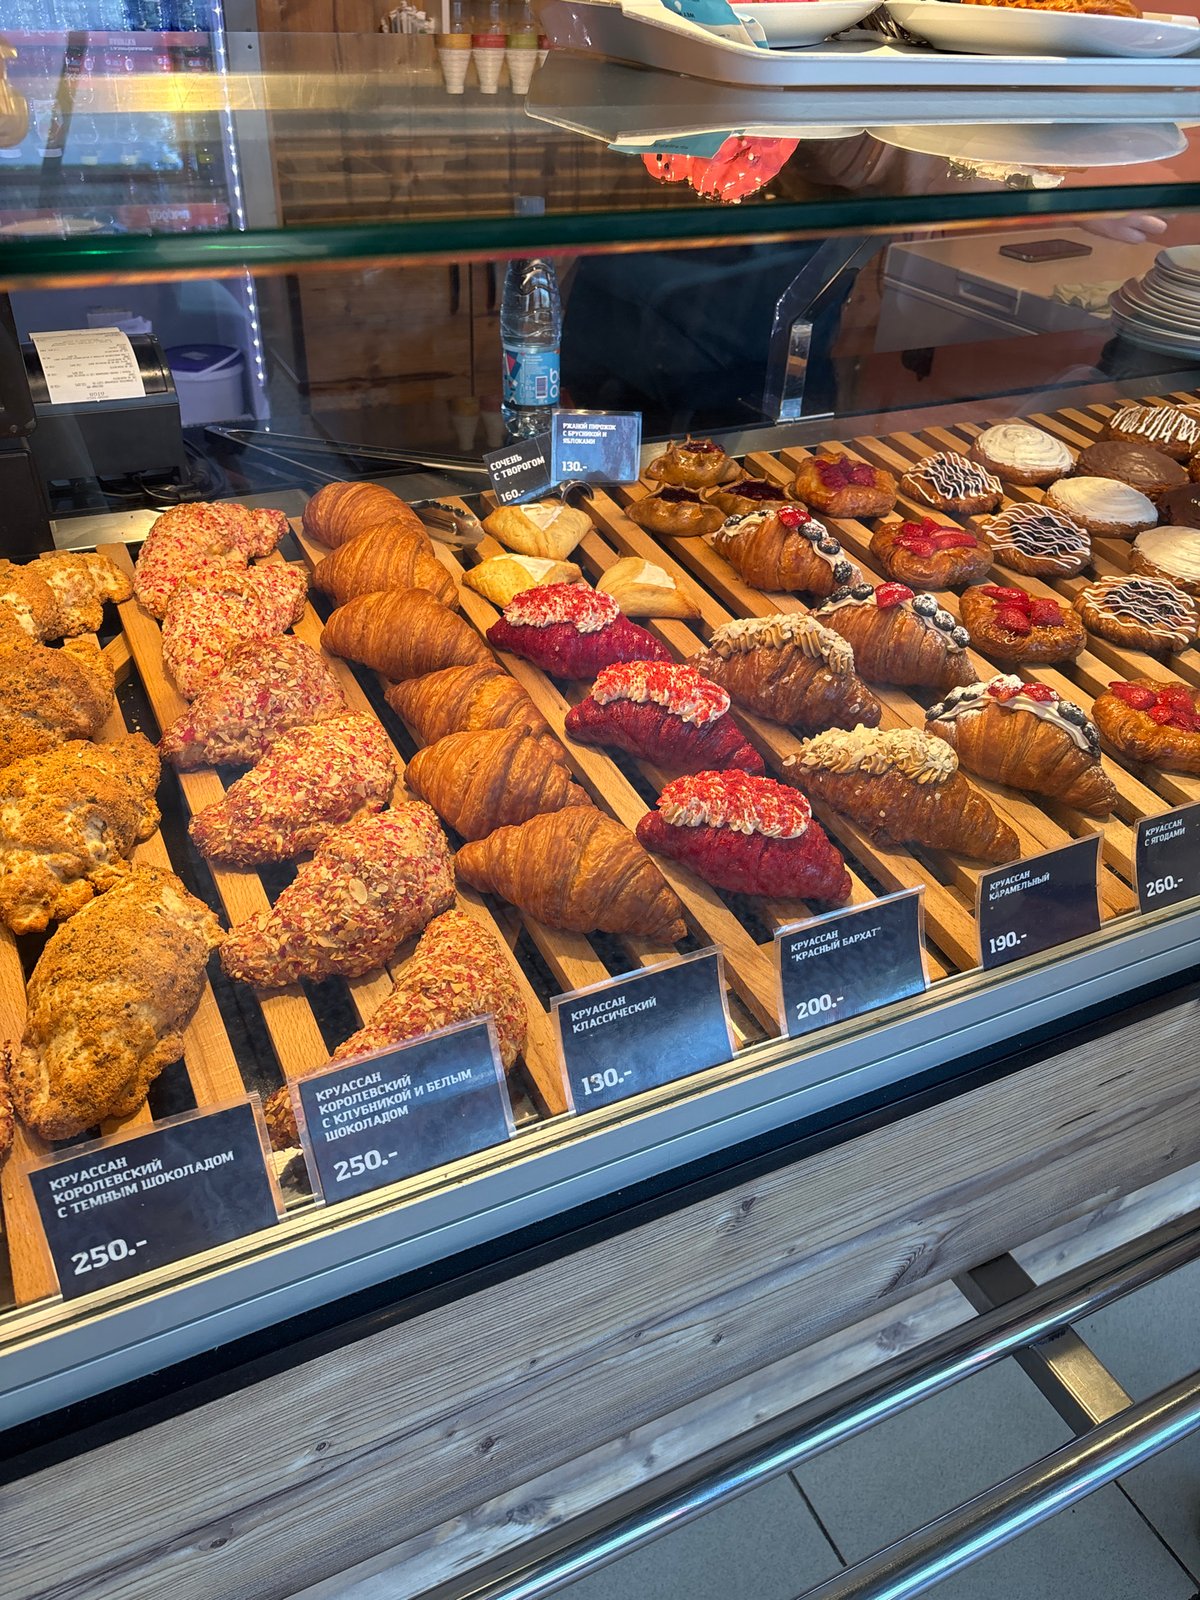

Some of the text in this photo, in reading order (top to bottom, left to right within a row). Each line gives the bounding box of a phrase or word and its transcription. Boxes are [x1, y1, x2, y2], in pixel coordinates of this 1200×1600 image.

[490, 454, 523, 471] СОЧЕНЬ
[493, 455, 545, 481] С ТВОРОГОМ
[562, 460, 588, 472] 130.-
[500, 488, 525, 503] 160.-
[1144, 827, 1186, 847] С ЯГОДАМИ
[1145, 818, 1183, 837] КРУАССАН
[989, 870, 1030, 891] КРУАССАН
[989, 871, 1050, 901] КАРАМЕЛЬНЫЙ
[1146, 875, 1184, 898] 260.-
[790, 929, 839, 952] КРУАССАН
[791, 926, 881, 962] "КРАСНЫЙ БАРХАТ"
[989, 931, 1027, 954] 190.-
[571, 996, 626, 1022] КРУАССАН
[572, 996, 657, 1033] КЛАССИЧЕСКИЙ
[796, 993, 844, 1020] 200.-
[316, 1072, 382, 1102] КРУАССАН
[319, 1074, 411, 1115] КОРОЛЕВСКИЙ
[581, 1068, 632, 1095] 130.-
[322, 1117, 331, 1129] С
[333, 1089, 411, 1125] КЛУБНИКОЙ
[415, 1086, 424, 1097] И
[427, 1069, 473, 1093] БЕЛЫМ
[325, 1105, 409, 1142] ШОКОЛАДОМ
[50, 1157, 128, 1190] КРУАССАН
[333, 1149, 398, 1182] 250.-
[53, 1159, 163, 1204] КОРОЛЕВСКИЙ
[57, 1151, 234, 1218] С ТЕМНЫМ ШОКОЛАДОМ
[71, 1239, 147, 1275] 250.-
